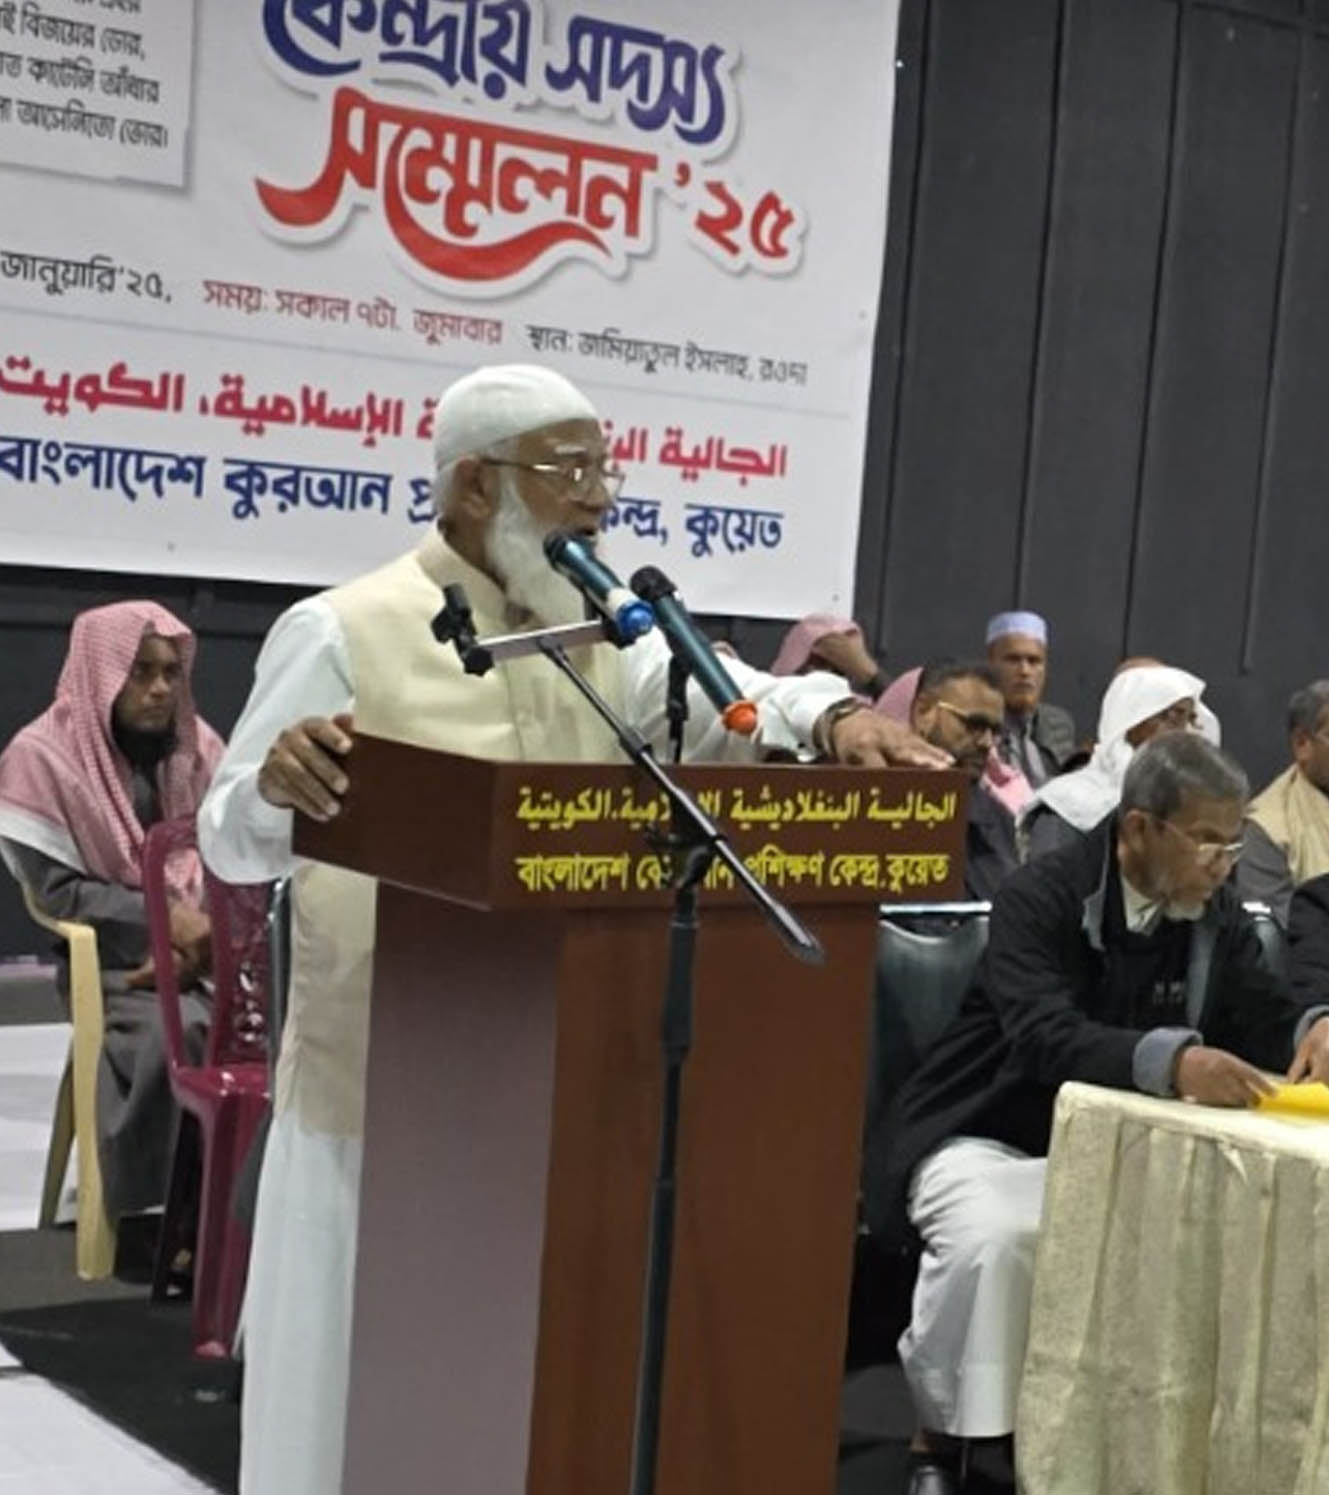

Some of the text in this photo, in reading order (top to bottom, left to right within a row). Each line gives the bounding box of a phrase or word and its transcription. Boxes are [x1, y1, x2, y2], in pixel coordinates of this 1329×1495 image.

[20, 1, 95, 48] বিজয়ের
[546, 16, 725, 145] সদস্য
[255, 86, 656, 281] সম্মেলন
[275, 289, 349, 324] সকাল
[0, 355, 185, 416] الكويت
[658, 427, 787, 487] الجالية
[0, 435, 206, 501] বাংলাদেশ
[224, 458, 393, 520] কুরআন
[684, 503, 785, 558] কুয়েত
[867, 787, 958, 830] الجالية
[515, 853, 630, 891] বাংলাদেশ
